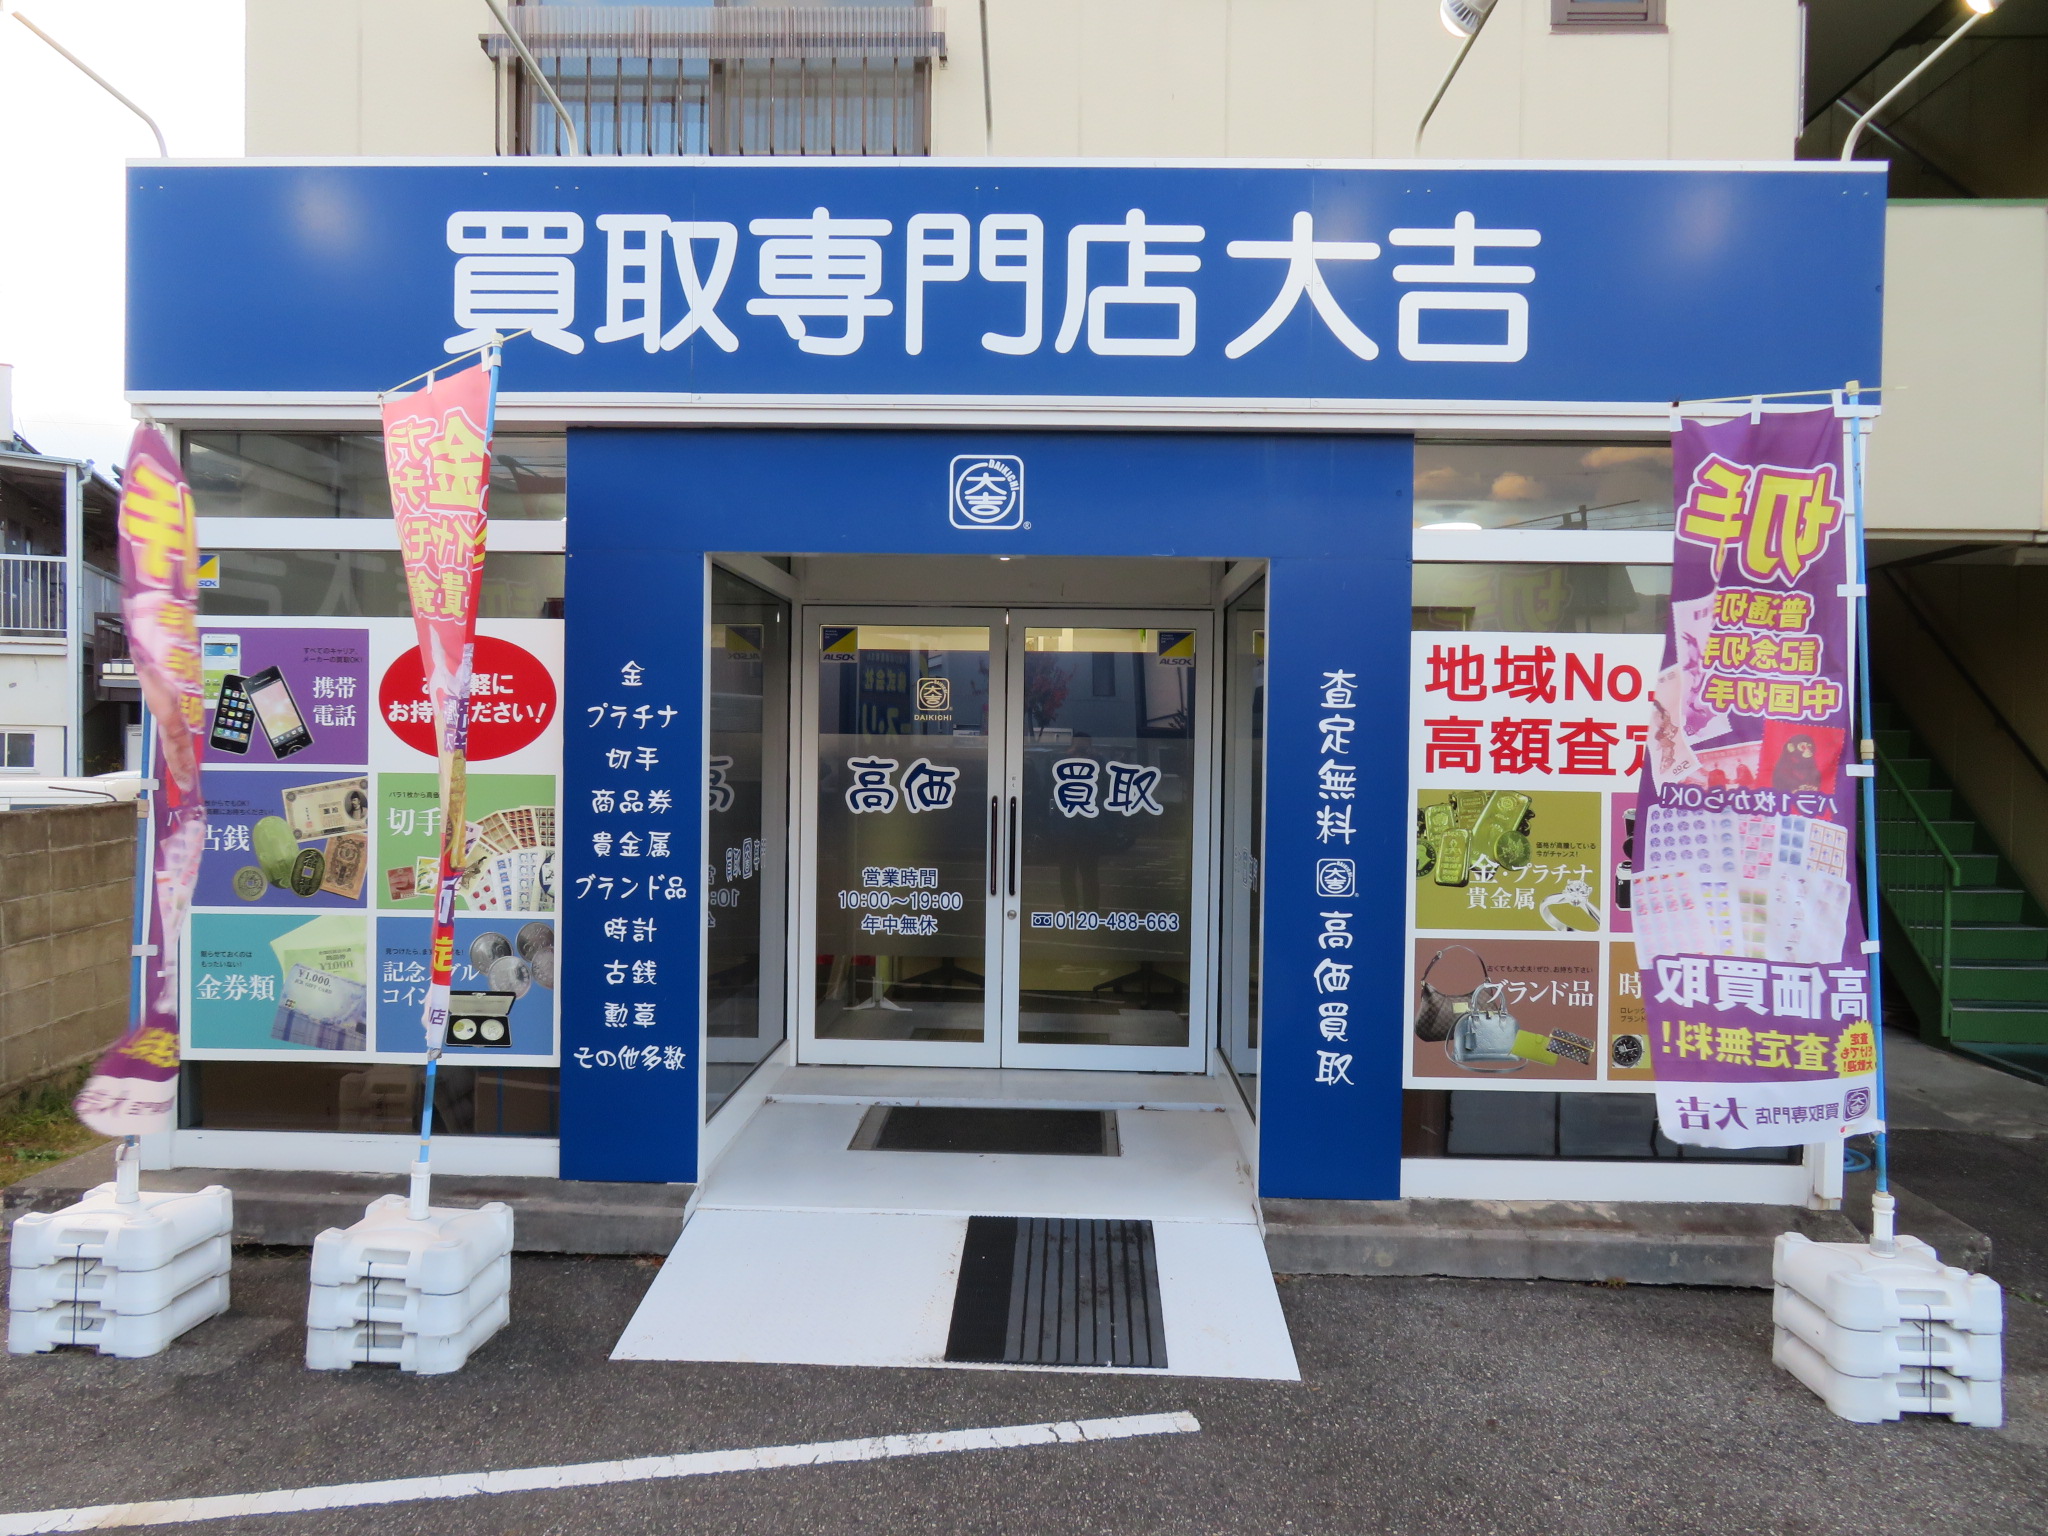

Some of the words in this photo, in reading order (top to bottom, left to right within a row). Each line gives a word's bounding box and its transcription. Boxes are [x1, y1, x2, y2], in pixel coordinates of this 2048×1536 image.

[444, 206, 1542, 363] 買取専門店大吉
[988, 459, 1020, 491] DAIKICHI
[823, 653, 855, 661] ALSOK
[1160, 658, 1192, 666] ALSOK
[621, 661, 645, 687] 金
[313, 676, 357, 699] 携帯
[313, 704, 357, 727] 電話
[388, 700, 547, 724] お持ださい!
[587, 702, 678, 730] プラチナ
[914, 714, 952, 722] DAIKICHI
[606, 746, 659, 772] 切手
[1316, 669, 1358, 845] 査定無料
[846, 756, 960, 814] 高価
[1053, 758, 1164, 819] 買取
[591, 789, 673, 815] 商品券
[387, 807, 441, 837] 切手
[202, 824, 250, 852] 古銭
[592, 831, 671, 858] 貴金属
[1536, 850, 1579, 858] 今がチャンス!
[862, 867, 939, 889] 営業時間
[1469, 853, 1593, 885] 金・プラチナ
[575, 876, 687, 901] ブランド品
[1466, 886, 1535, 911] 貴金属
[604, 917, 657, 943] 時計
[862, 915, 939, 936] 年中無休
[1055, 912, 1180, 932] 0120-488-663
[382, 960, 481, 983] 記念ル
[604, 959, 657, 986] 古銭
[196, 973, 276, 1002] 金券類
[382, 986, 427, 1007] コイン
[1313, 911, 1355, 1086] 高価買取
[1483, 978, 1594, 1007] ブランド品
[1619, 971, 1643, 1000] 時
[604, 1002, 657, 1029] 勲章
[573, 1045, 687, 1072] その他多数
